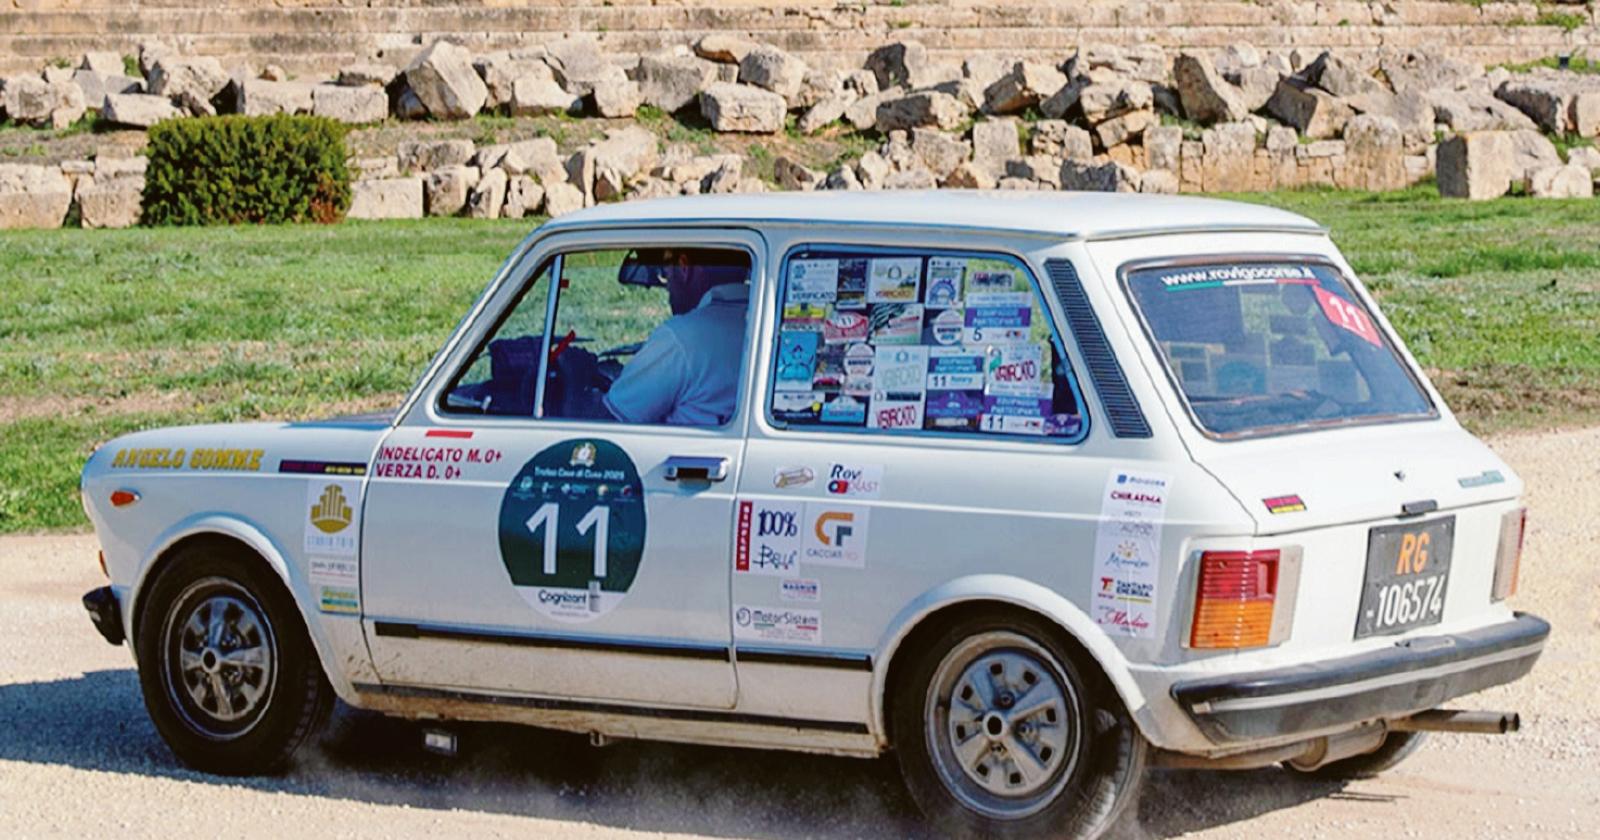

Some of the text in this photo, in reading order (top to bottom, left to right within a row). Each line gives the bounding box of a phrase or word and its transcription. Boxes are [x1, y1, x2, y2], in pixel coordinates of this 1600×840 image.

[1161, 265, 1317, 286] www.rovigocorse.it
[1328, 295, 1367, 333] 11
[972, 327, 982, 342] 5
[932, 375, 947, 387] 11
[989, 415, 1004, 429] 11
[111, 448, 186, 468] ANGELO
[189, 448, 265, 470] GOMME
[377, 447, 463, 462] INDELICATO
[376, 463, 422, 478] VERZA
[426, 465, 440, 479] D.
[757, 508, 798, 537] 100%
[526, 502, 610, 577] 11
[1395, 532, 1431, 576] RG
[1375, 572, 1446, 628] 106574
